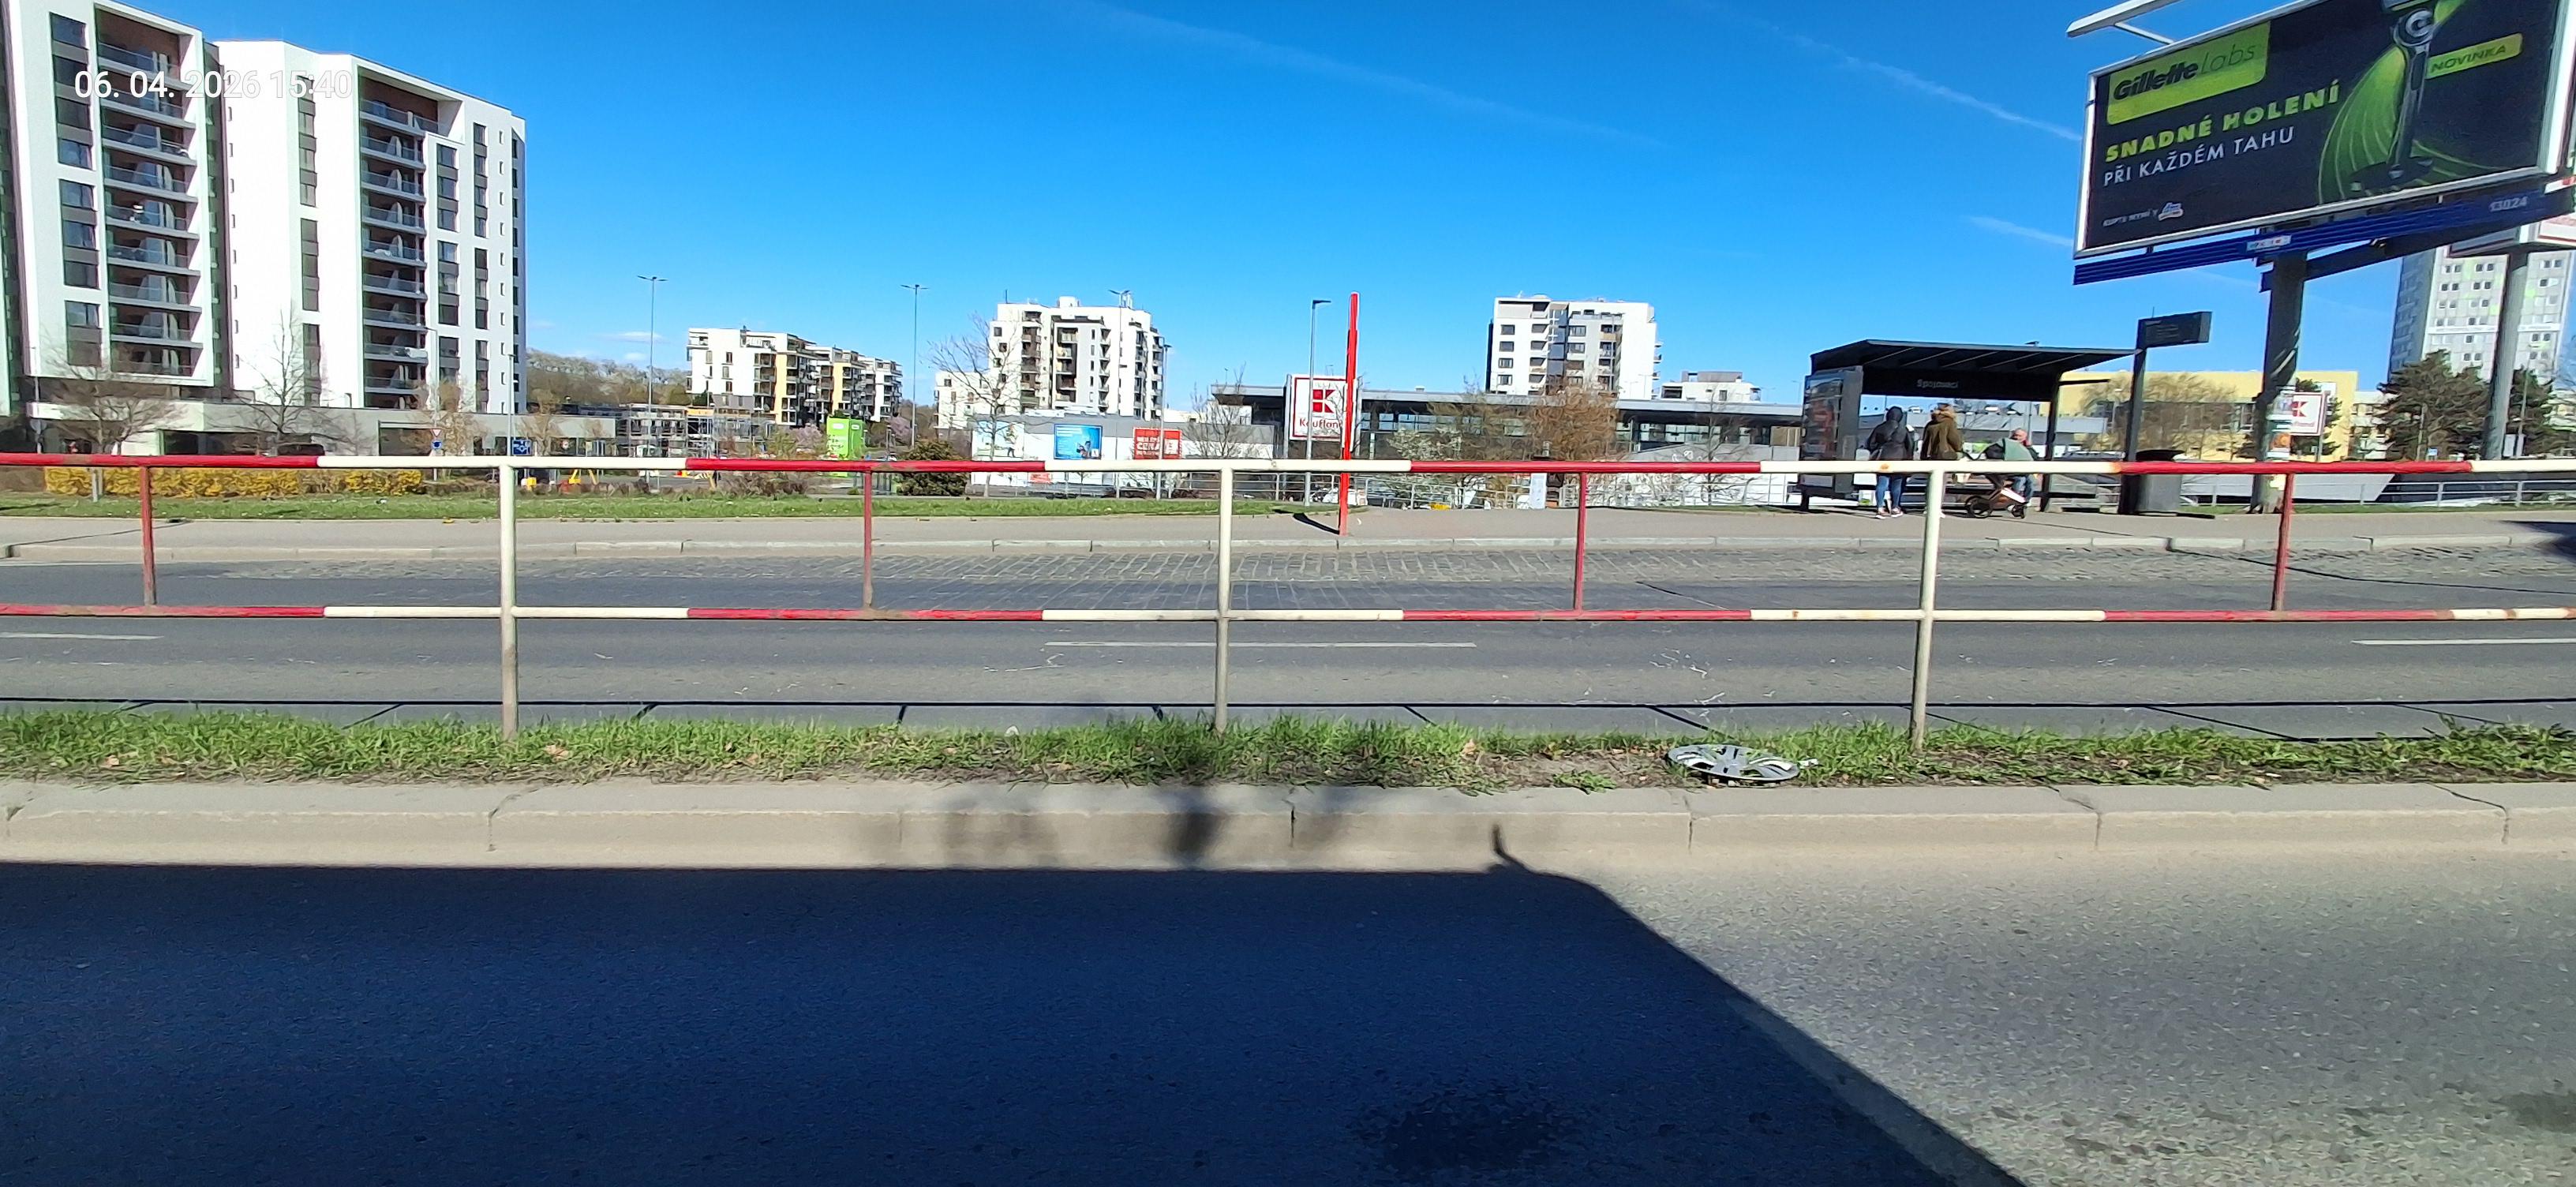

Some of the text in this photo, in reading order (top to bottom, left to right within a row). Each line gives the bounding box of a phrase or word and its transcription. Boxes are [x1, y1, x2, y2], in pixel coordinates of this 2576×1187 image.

[2431, 45, 2506, 73] NOVINKA
[2105, 79, 2340, 163] SNADNÉ HOLENÍ
[2103, 126, 2295, 187] PŘI KAŽDÉM TAHU
